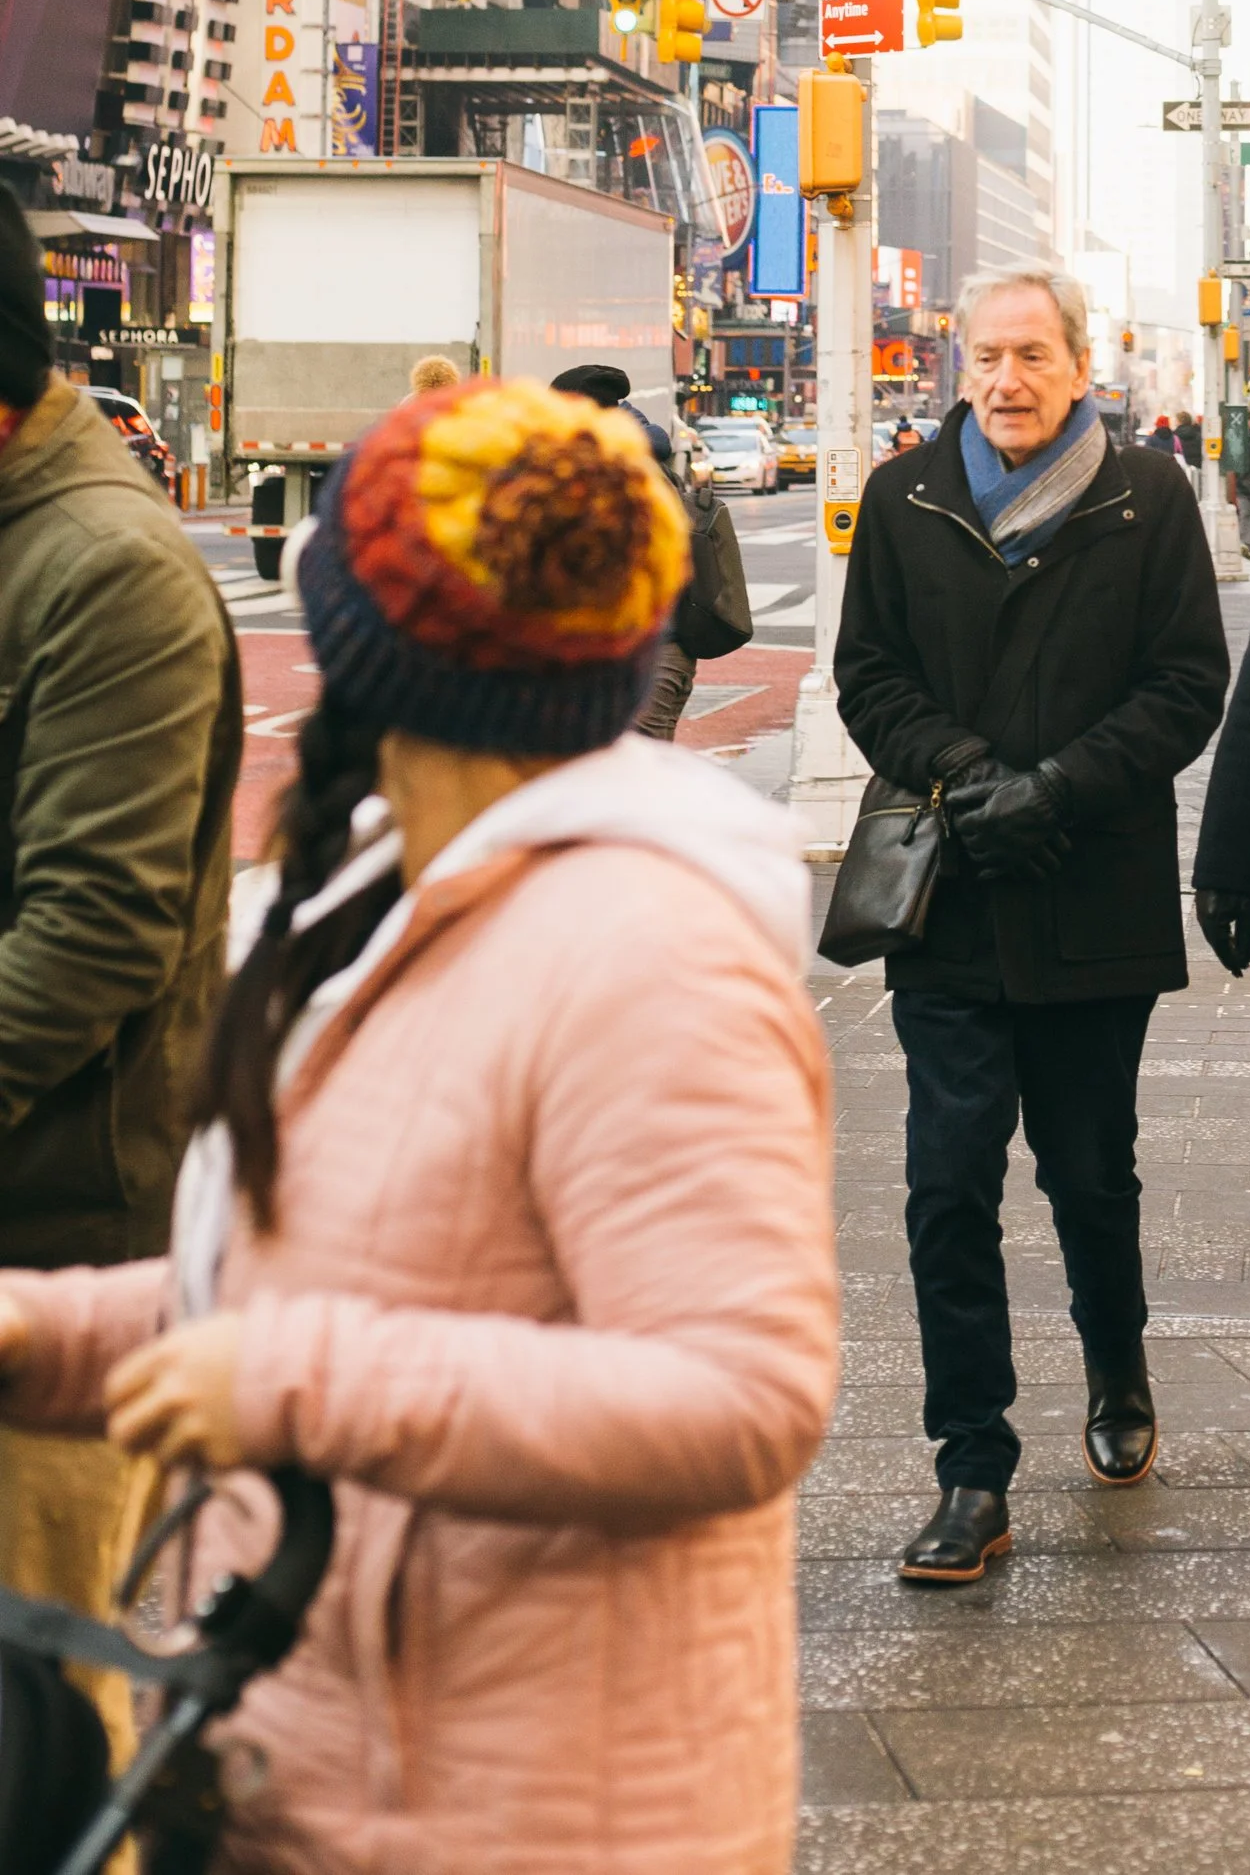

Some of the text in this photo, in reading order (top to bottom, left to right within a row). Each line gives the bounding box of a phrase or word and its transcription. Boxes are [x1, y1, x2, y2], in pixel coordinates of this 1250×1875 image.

[823, 1, 869, 23] Anytime
[143, 142, 214, 208] SEPHO
[98, 328, 179, 344] SEPHORA
